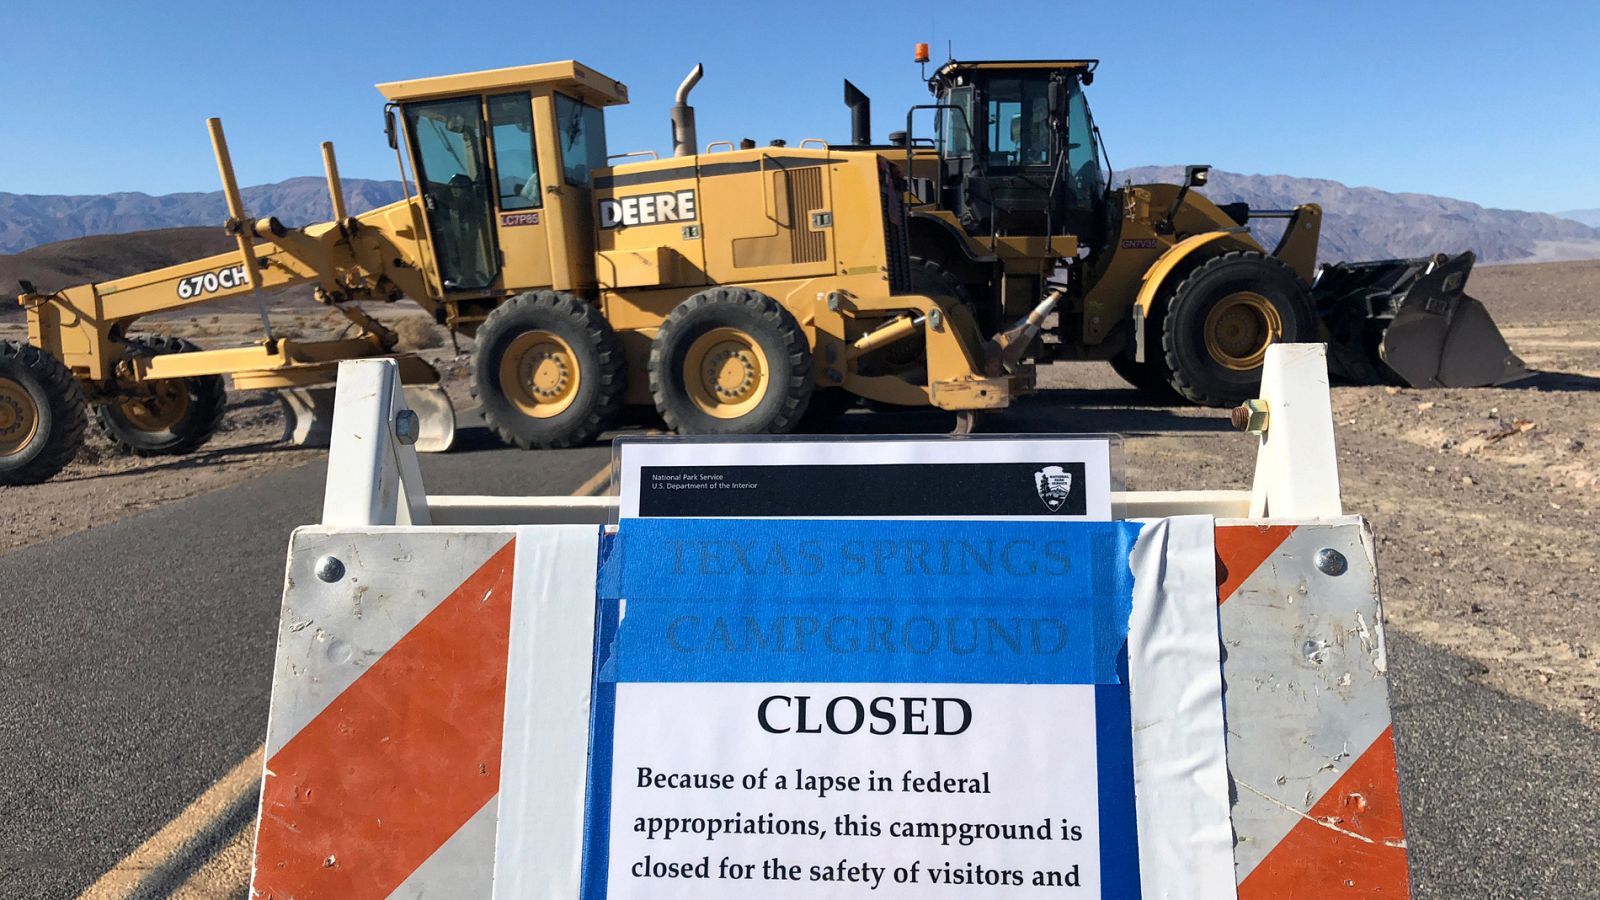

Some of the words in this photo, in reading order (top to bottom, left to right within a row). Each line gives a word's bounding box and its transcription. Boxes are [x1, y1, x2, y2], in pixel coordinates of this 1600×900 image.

[599, 189, 697, 229] DEERE
[177, 264, 249, 299] 670CH
[665, 538, 822, 577] TEXAS
[841, 538, 1071, 577] SPRINGS
[666, 614, 1068, 656] CAMPGROUND
[757, 695, 973, 736] CLOSED
[636, 767, 735, 790] Because
[742, 768, 767, 790] of
[775, 775, 788, 790] a
[796, 768, 861, 798] lapse
[868, 770, 893, 792] in
[902, 770, 991, 794] federal
[633, 811, 827, 841] appropriations,
[834, 813, 882, 837] this
[889, 817, 1052, 845] campground
[1060, 818, 1083, 842] is
[631, 855, 710, 879] closed
[718, 856, 755, 880] for
[762, 858, 802, 881] the
[809, 859, 886, 890] safety
[893, 860, 920, 884] of
[927, 861, 1024, 886] visitors
[1032, 864, 1081, 887] and
